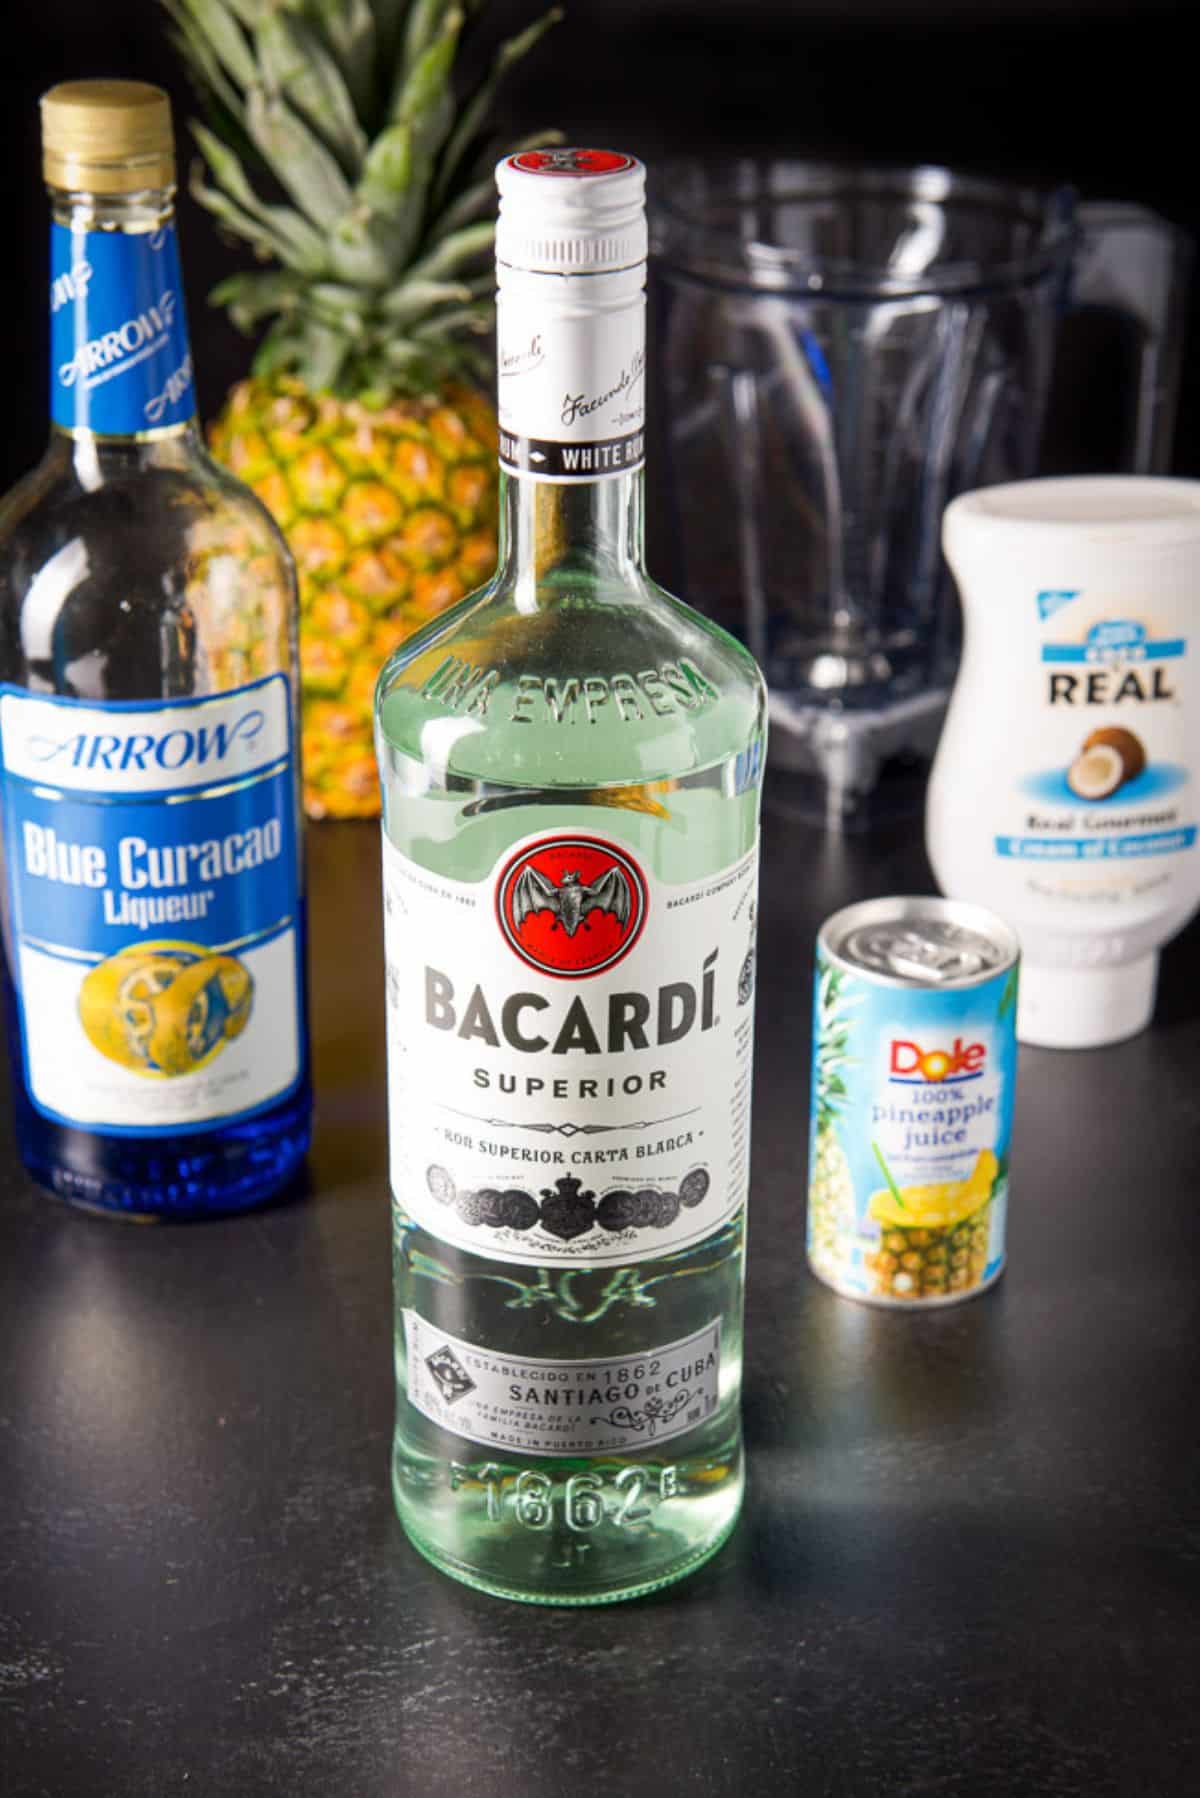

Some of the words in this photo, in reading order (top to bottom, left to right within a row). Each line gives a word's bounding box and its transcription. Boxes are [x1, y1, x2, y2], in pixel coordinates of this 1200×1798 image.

[562, 443, 622, 470] WHITE
[509, 656, 720, 725] EMPRESA
[1049, 666, 1172, 706] REAL
[27, 710, 265, 771] ARROW
[23, 820, 107, 888] Blue
[118, 818, 281, 890] Curacao
[103, 889, 214, 930] Liqueur
[425, 946, 718, 1055] BACARDÍ
[891, 1037, 987, 1082] Dole
[473, 1068, 667, 1099] SUPERIOR
[913, 1088, 964, 1104] 100%
[872, 1094, 995, 1126] pineapple
[479, 1140, 565, 1164] SUPERIOR
[571, 1147, 629, 1165] CARTA
[635, 1132, 694, 1159] BLANCA
[904, 1127, 967, 1149] juice
[465, 1355, 569, 1382] ESTABLECIDO
[603, 1360, 662, 1385] 1862
[509, 1383, 640, 1406] SANTIAGO
[645, 1383, 661, 1396] DE
[666, 1352, 715, 1388] CUBA
[493, 1406, 543, 1421] EMPRESA
[490, 1431, 521, 1444] MADE
[545, 1440, 593, 1449] PUERTO
[598, 1436, 627, 1447] RICO
[477, 1463, 654, 1533] 1862
